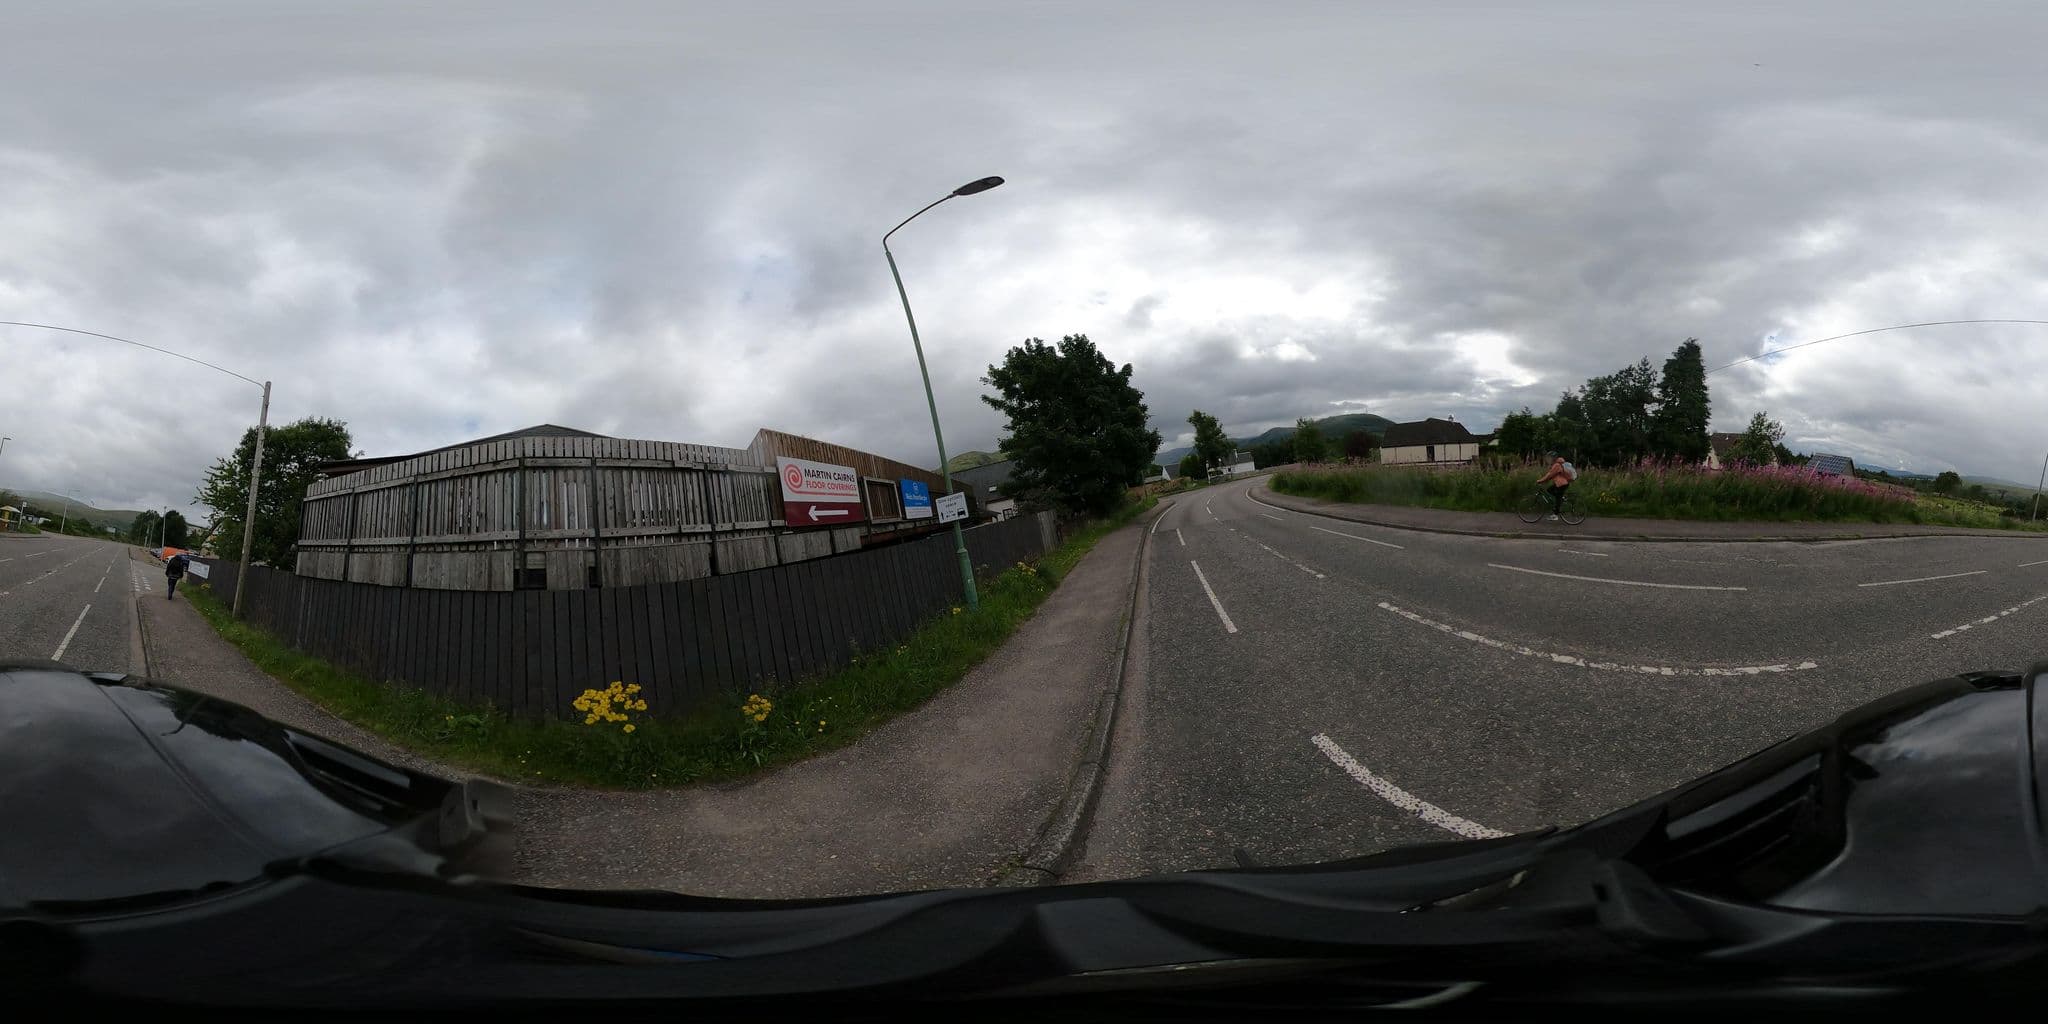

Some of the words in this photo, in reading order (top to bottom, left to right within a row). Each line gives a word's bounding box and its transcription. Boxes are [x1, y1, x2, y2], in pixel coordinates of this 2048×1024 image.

[804, 468, 832, 480] MARTIN
[833, 472, 855, 482] CAIRNS
[806, 480, 825, 488] FLOOR
[827, 482, 857, 490] COVERINGS
